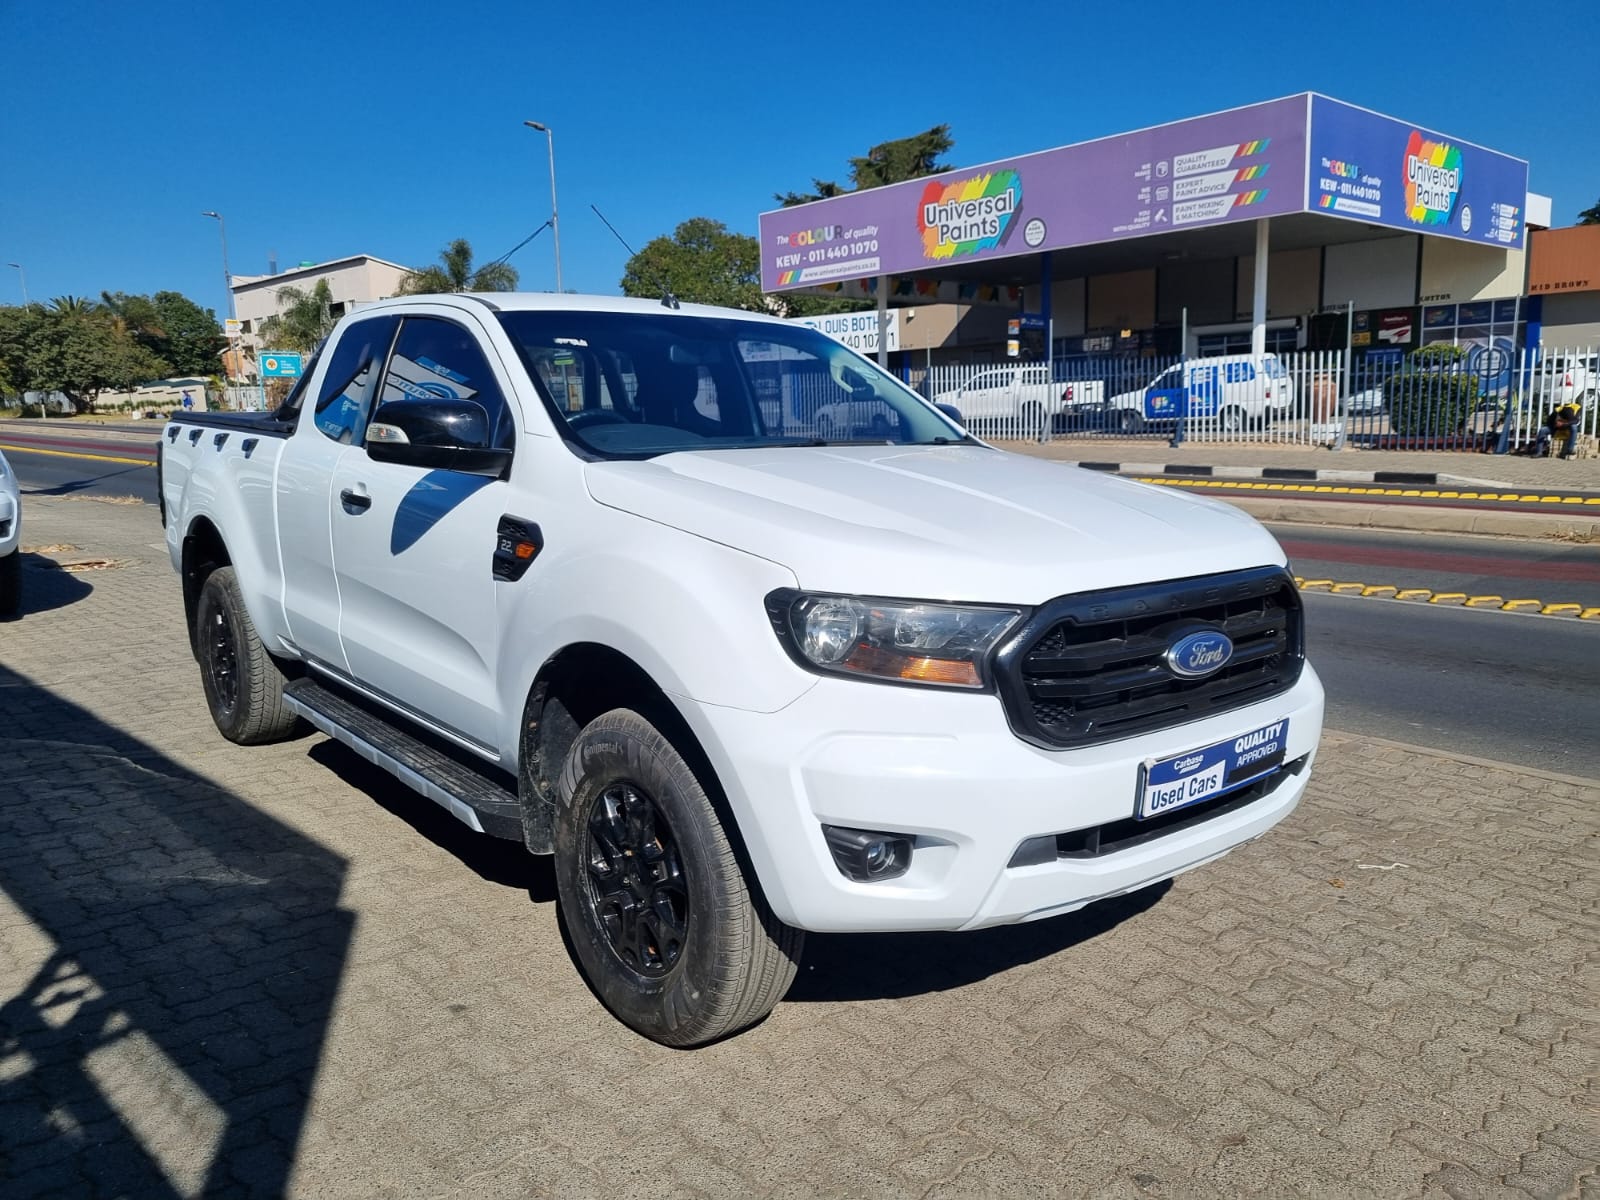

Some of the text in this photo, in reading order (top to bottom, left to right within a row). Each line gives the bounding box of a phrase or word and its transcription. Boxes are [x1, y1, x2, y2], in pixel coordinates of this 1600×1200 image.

[1176, 154, 1208, 166] QUALITY
[1176, 158, 1226, 174] GUARANTEED
[1330, 160, 1362, 179] COLOUR
[1176, 178, 1204, 190] EXPERT
[1409, 158, 1458, 190] Universal
[1176, 183, 1226, 197] PAINT ADVICE
[1320, 178, 1338, 192] KEW
[1341, 182, 1352, 195] 011
[1352, 185, 1365, 198] 440
[1365, 188, 1381, 201] 1070
[1416, 184, 1450, 210] Paints
[926, 190, 1012, 224] Universal
[1181, 210, 1220, 220] MATCHING
[1199, 200, 1225, 210] MIXING
[776, 224, 878, 248] The COLOUR of quality
[940, 217, 998, 242] Paints
[776, 253, 801, 268] KEW
[808, 248, 825, 262] 011
[827, 246, 848, 260] 440
[850, 240, 878, 256] 1070
[1554, 280, 1588, 288] BROWN
[1189, 640, 1223, 668] Ford
[1235, 722, 1284, 752] QUALITY
[1174, 754, 1204, 770] Carbase
[1236, 742, 1278, 767] APPROVED
[1151, 774, 1217, 810] Used Cars
